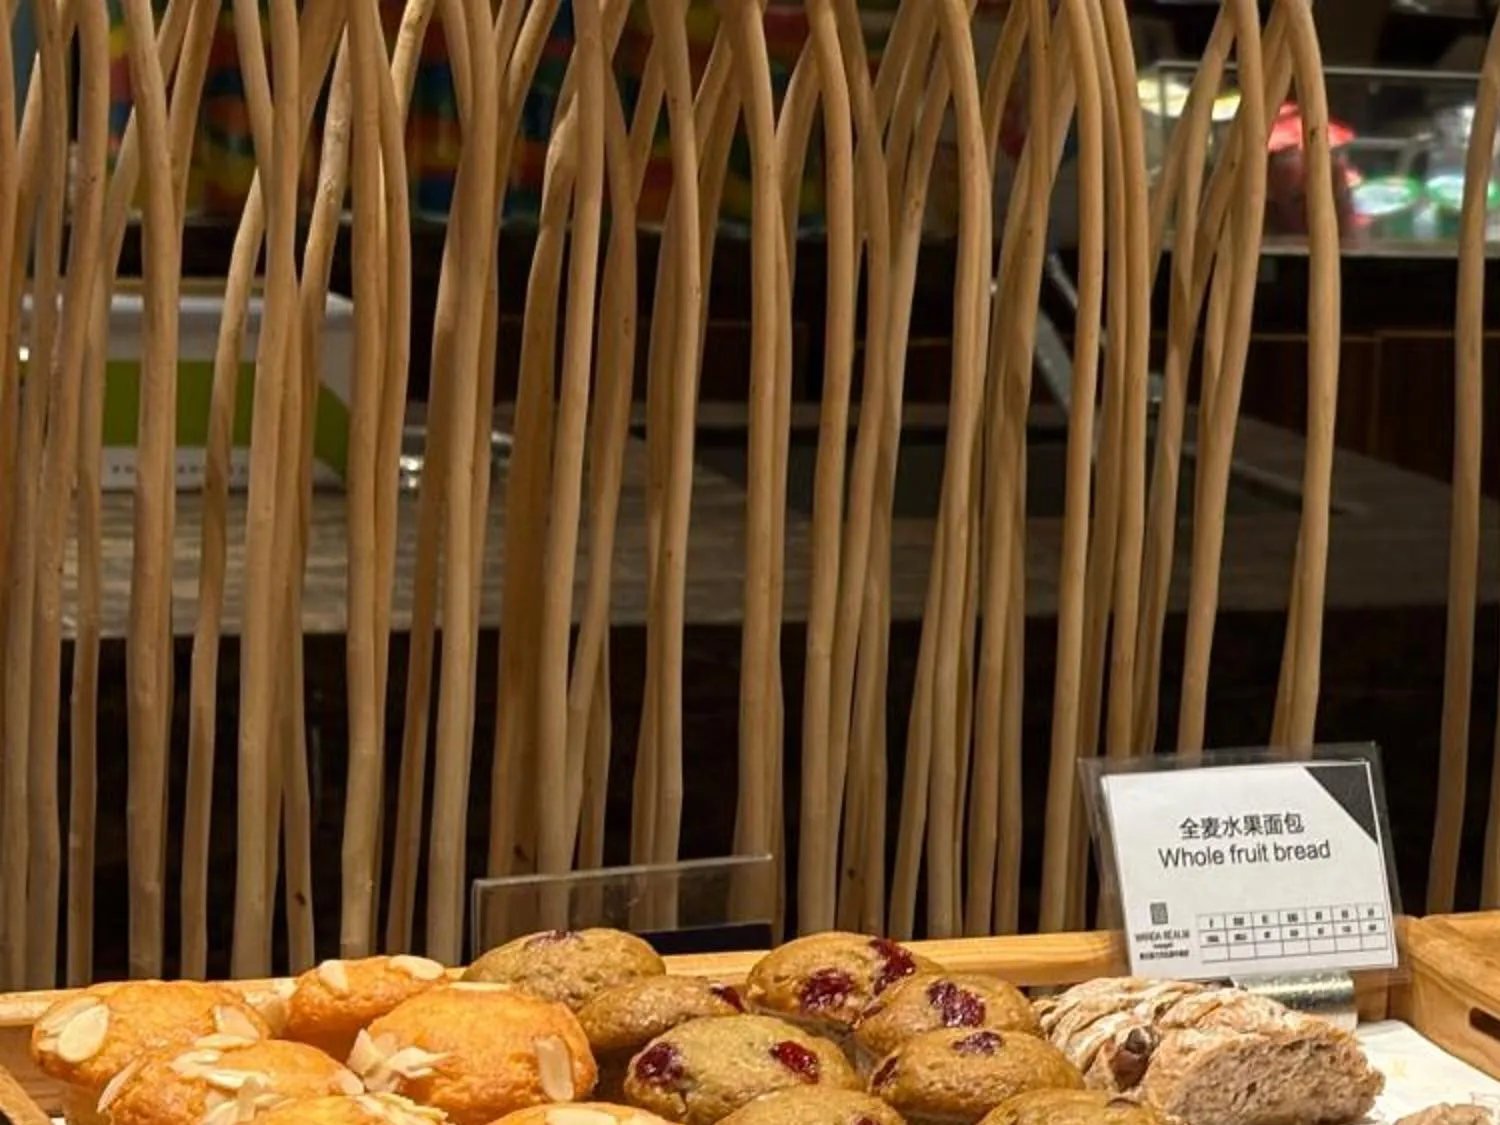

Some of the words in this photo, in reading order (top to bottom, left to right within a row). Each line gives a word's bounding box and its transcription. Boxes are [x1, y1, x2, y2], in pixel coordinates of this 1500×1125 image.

[1179, 812, 1305, 839] 全麦水果面包
[1158, 846, 1225, 868] Whole
[1230, 842, 1269, 864] fruit
[1274, 840, 1331, 861] bread
